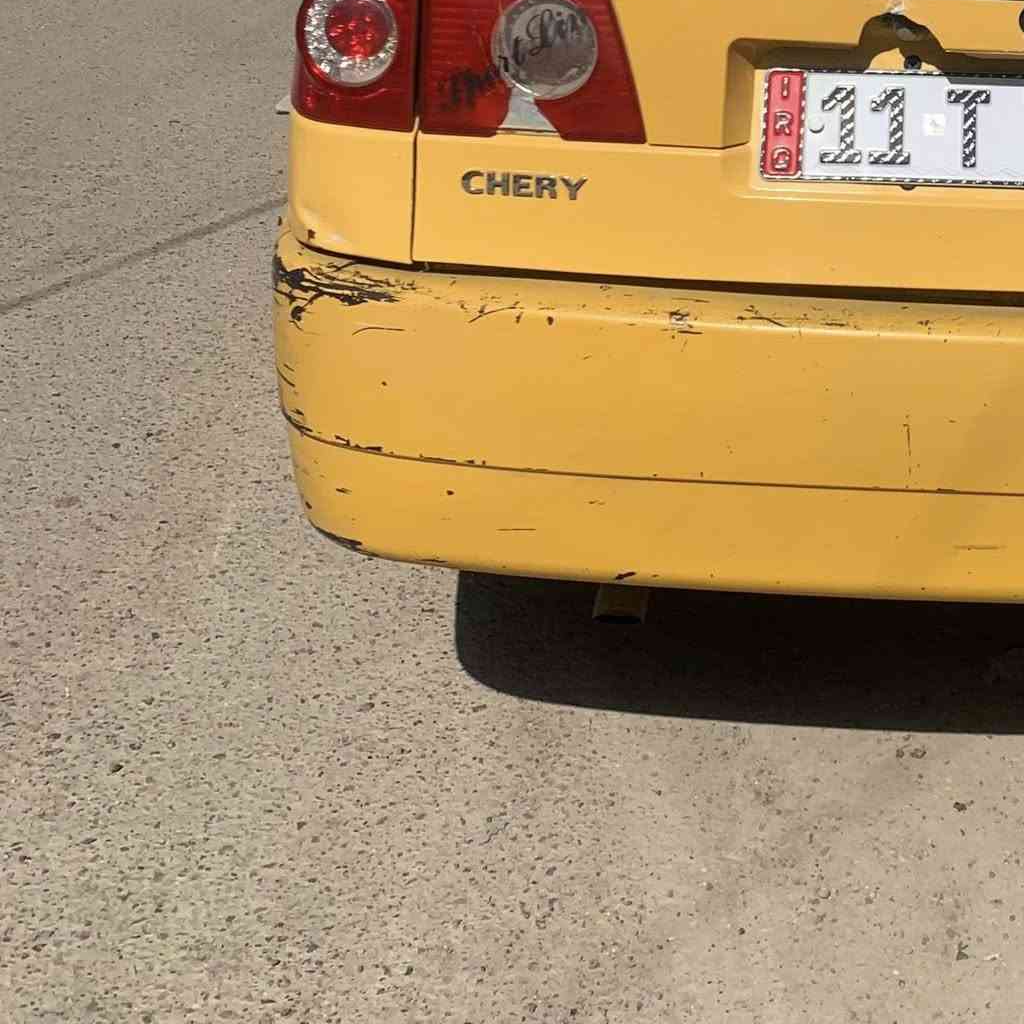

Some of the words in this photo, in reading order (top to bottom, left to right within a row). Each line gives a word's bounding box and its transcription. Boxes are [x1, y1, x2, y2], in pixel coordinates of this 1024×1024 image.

[819, 83, 911, 166] 11
[946, 88, 991, 169] T
[461, 170, 588, 201] CHERY
